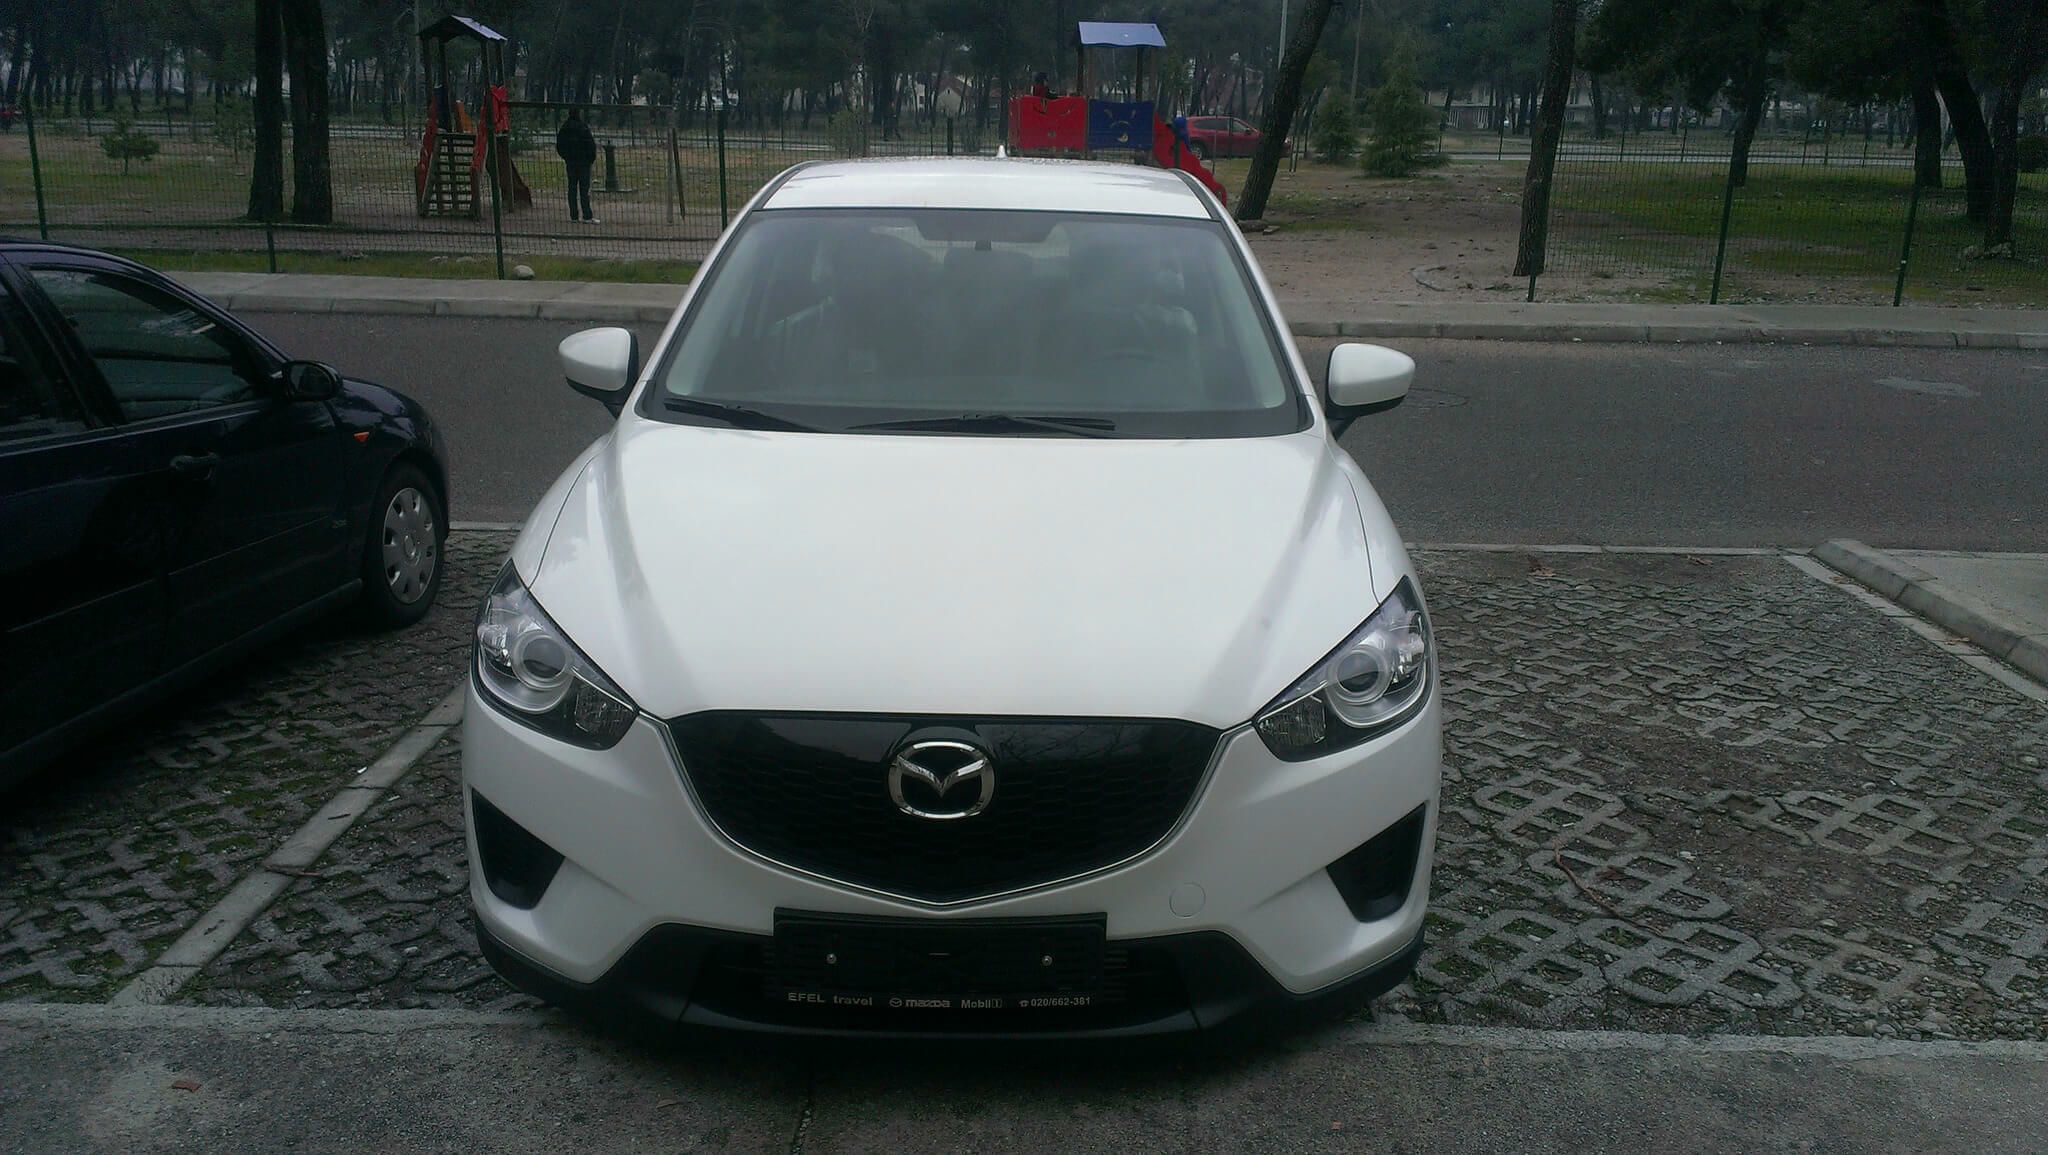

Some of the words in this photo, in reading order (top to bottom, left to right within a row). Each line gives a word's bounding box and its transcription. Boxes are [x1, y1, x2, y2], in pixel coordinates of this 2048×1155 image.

[788, 992, 825, 1003] EFEL
[833, 995, 873, 1006] travel
[905, 999, 951, 1008] mazda
[1031, 996, 1090, 1007] 020/662-381
